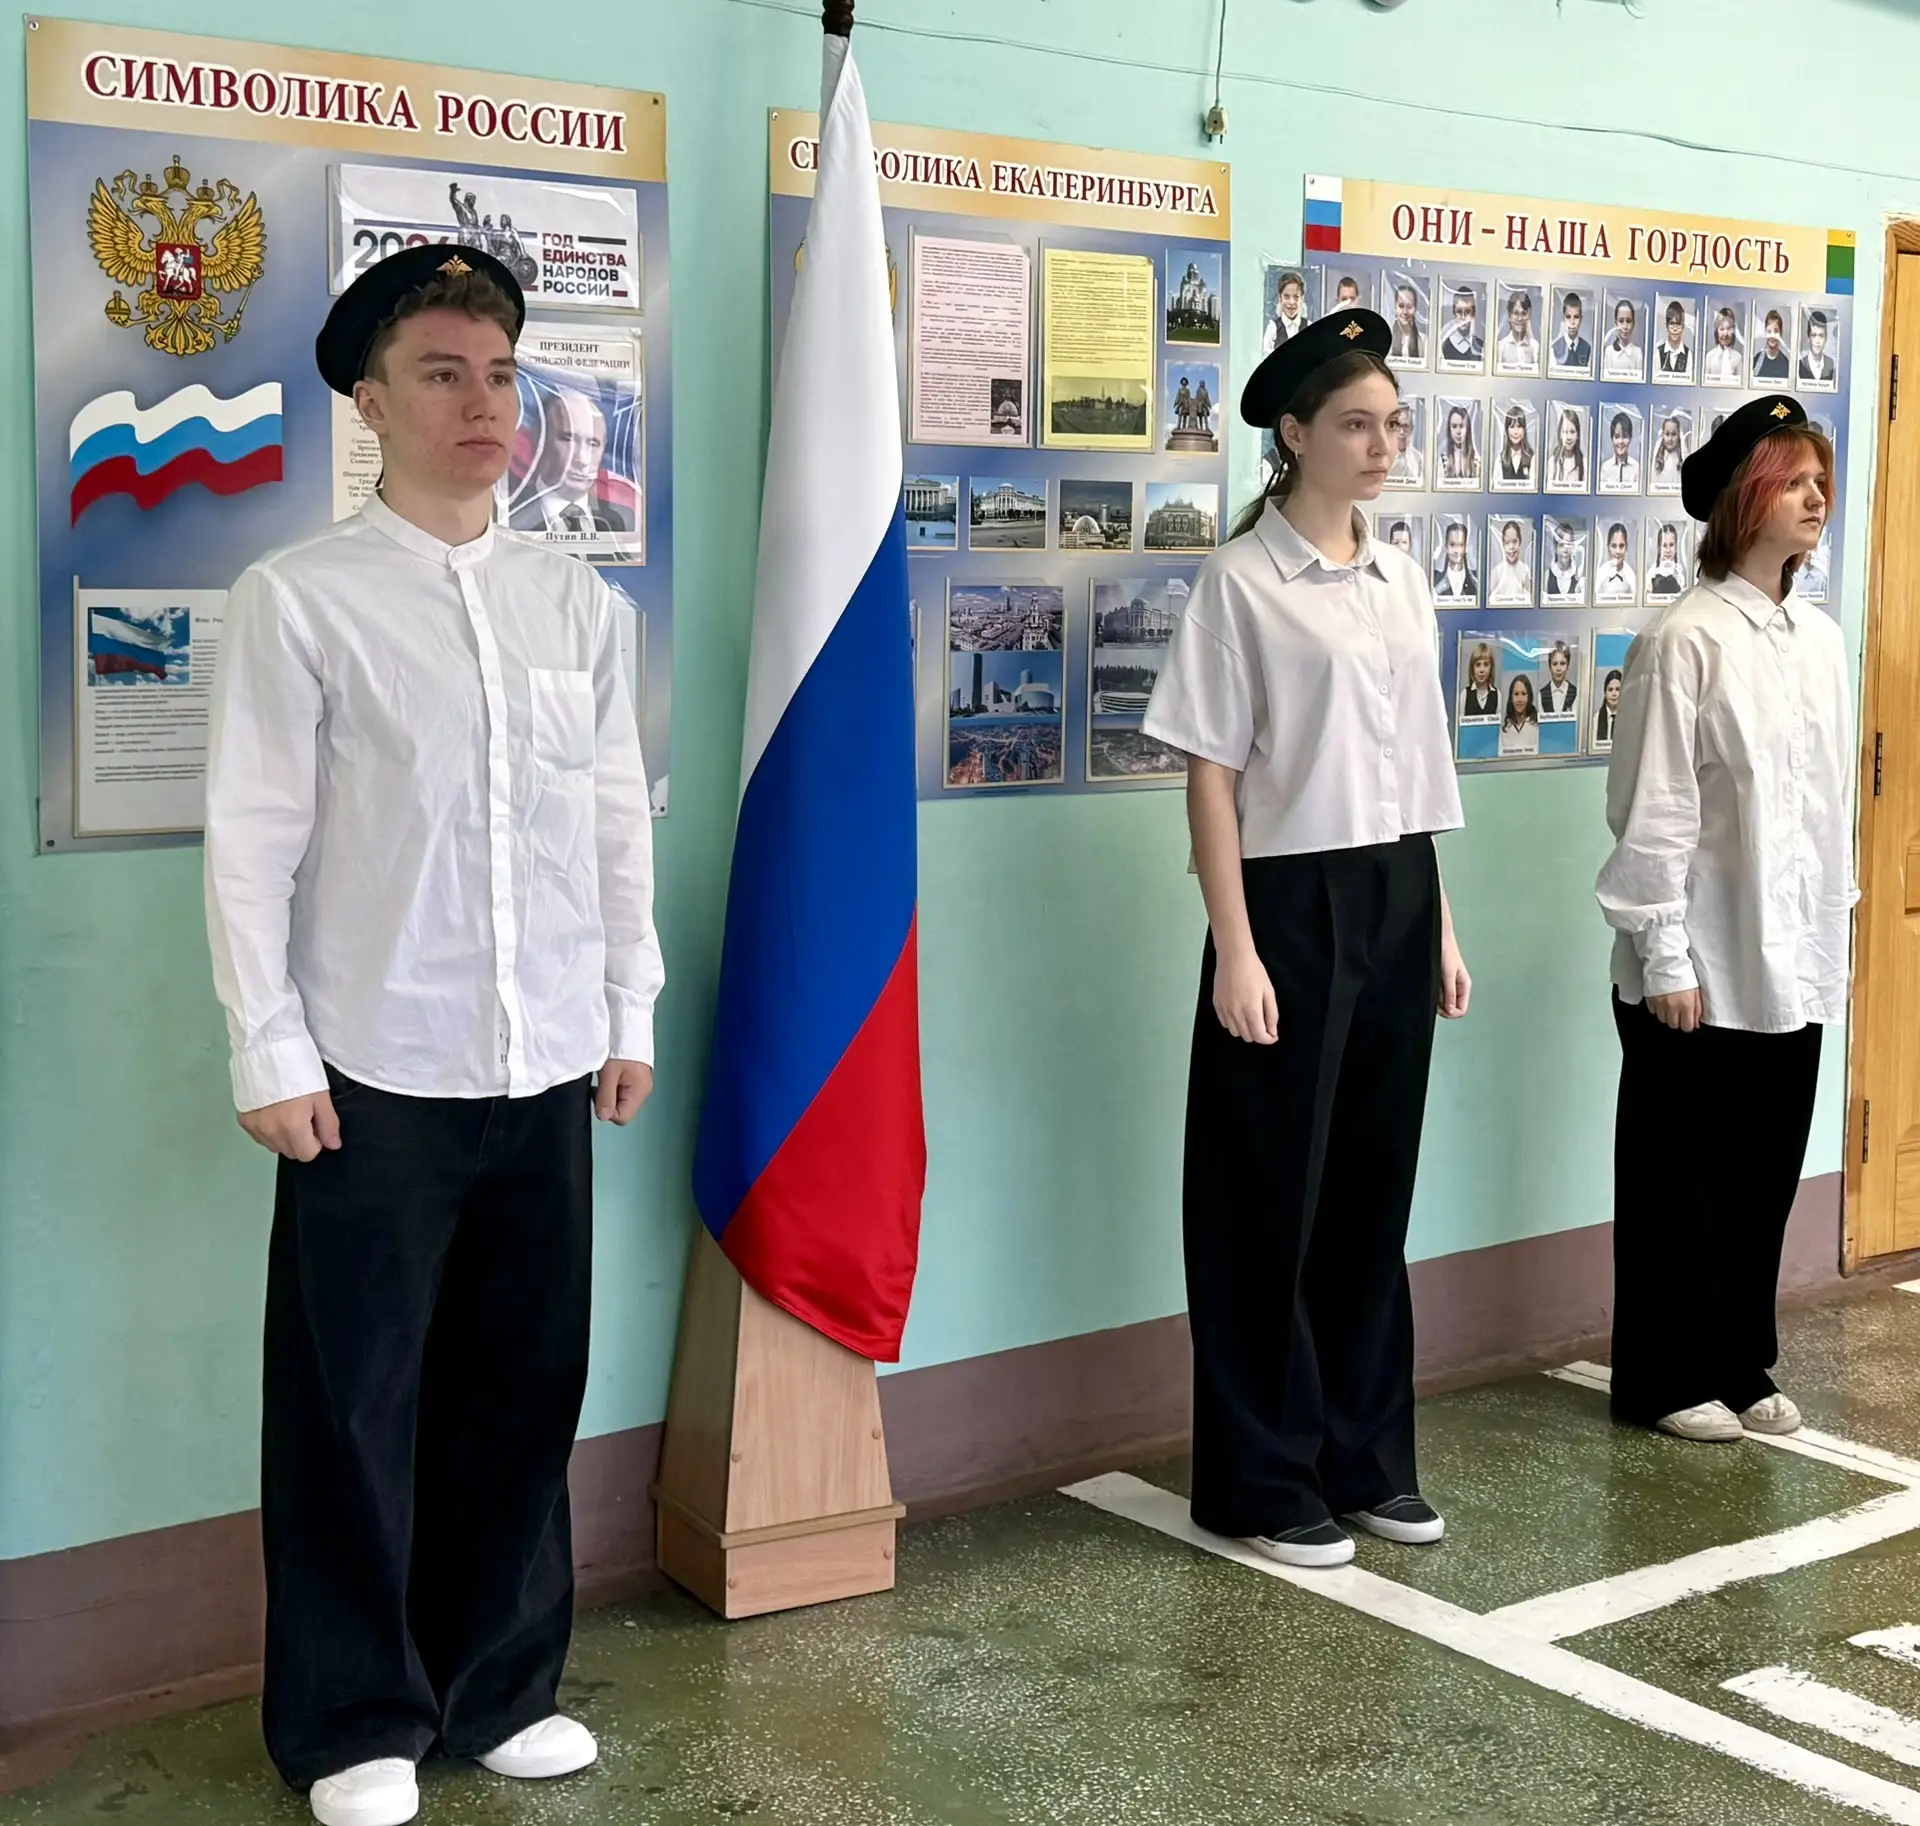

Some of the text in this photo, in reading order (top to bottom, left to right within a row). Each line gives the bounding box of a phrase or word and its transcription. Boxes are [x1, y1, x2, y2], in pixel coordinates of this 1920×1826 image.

[85, 55, 625, 152] СИМВОЛИКА РОССИИ
[790, 140, 1217, 214] СОЛИКА ЕКАТЕРИНБУРГА
[353, 229, 450, 268] 20
[542, 233, 574, 249] ГОД
[1392, 204, 1473, 246] ОНИ
[1504, 215, 1612, 258] НАША
[1627, 227, 1790, 275] ГОРДОСТЬ
[542, 248, 627, 267] ЕДИНСТВА
[543, 264, 619, 281] НАРОДОВ
[543, 280, 610, 297] РОССИИ
[540, 341, 600, 353] ПРЕЗИДЕНТ
